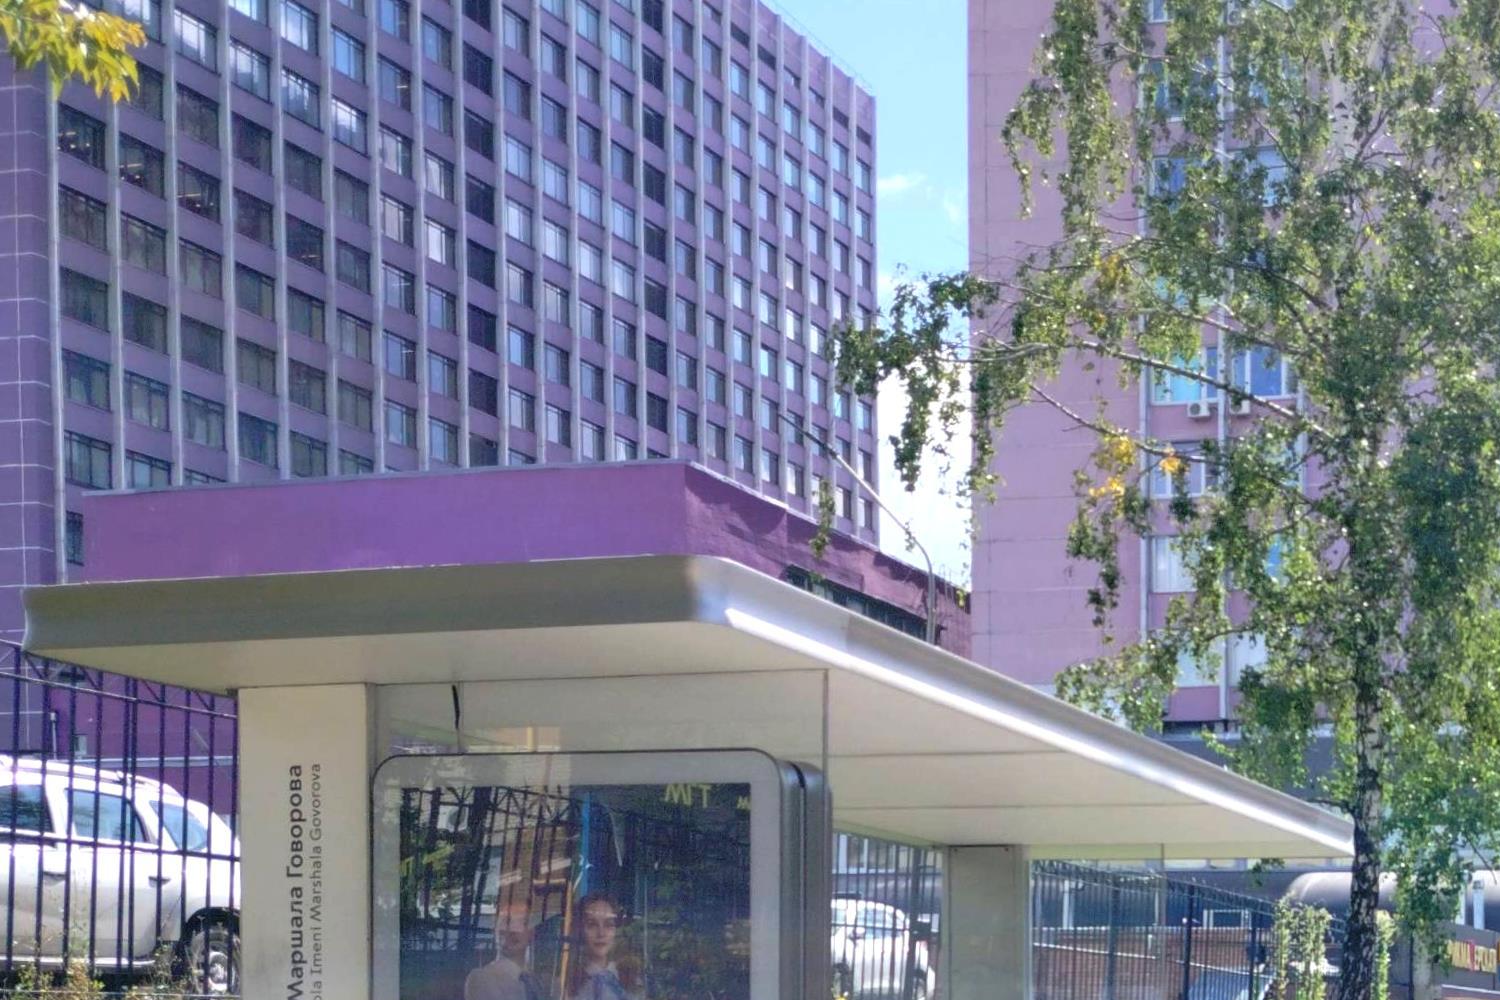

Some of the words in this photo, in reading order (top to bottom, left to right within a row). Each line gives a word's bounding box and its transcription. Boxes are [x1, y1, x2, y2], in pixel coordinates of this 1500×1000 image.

[286, 765, 307, 878] Говорова
[309, 763, 322, 841] Govorova
[309, 845, 322, 921] Marshala
[310, 926, 322, 975] Imeni
